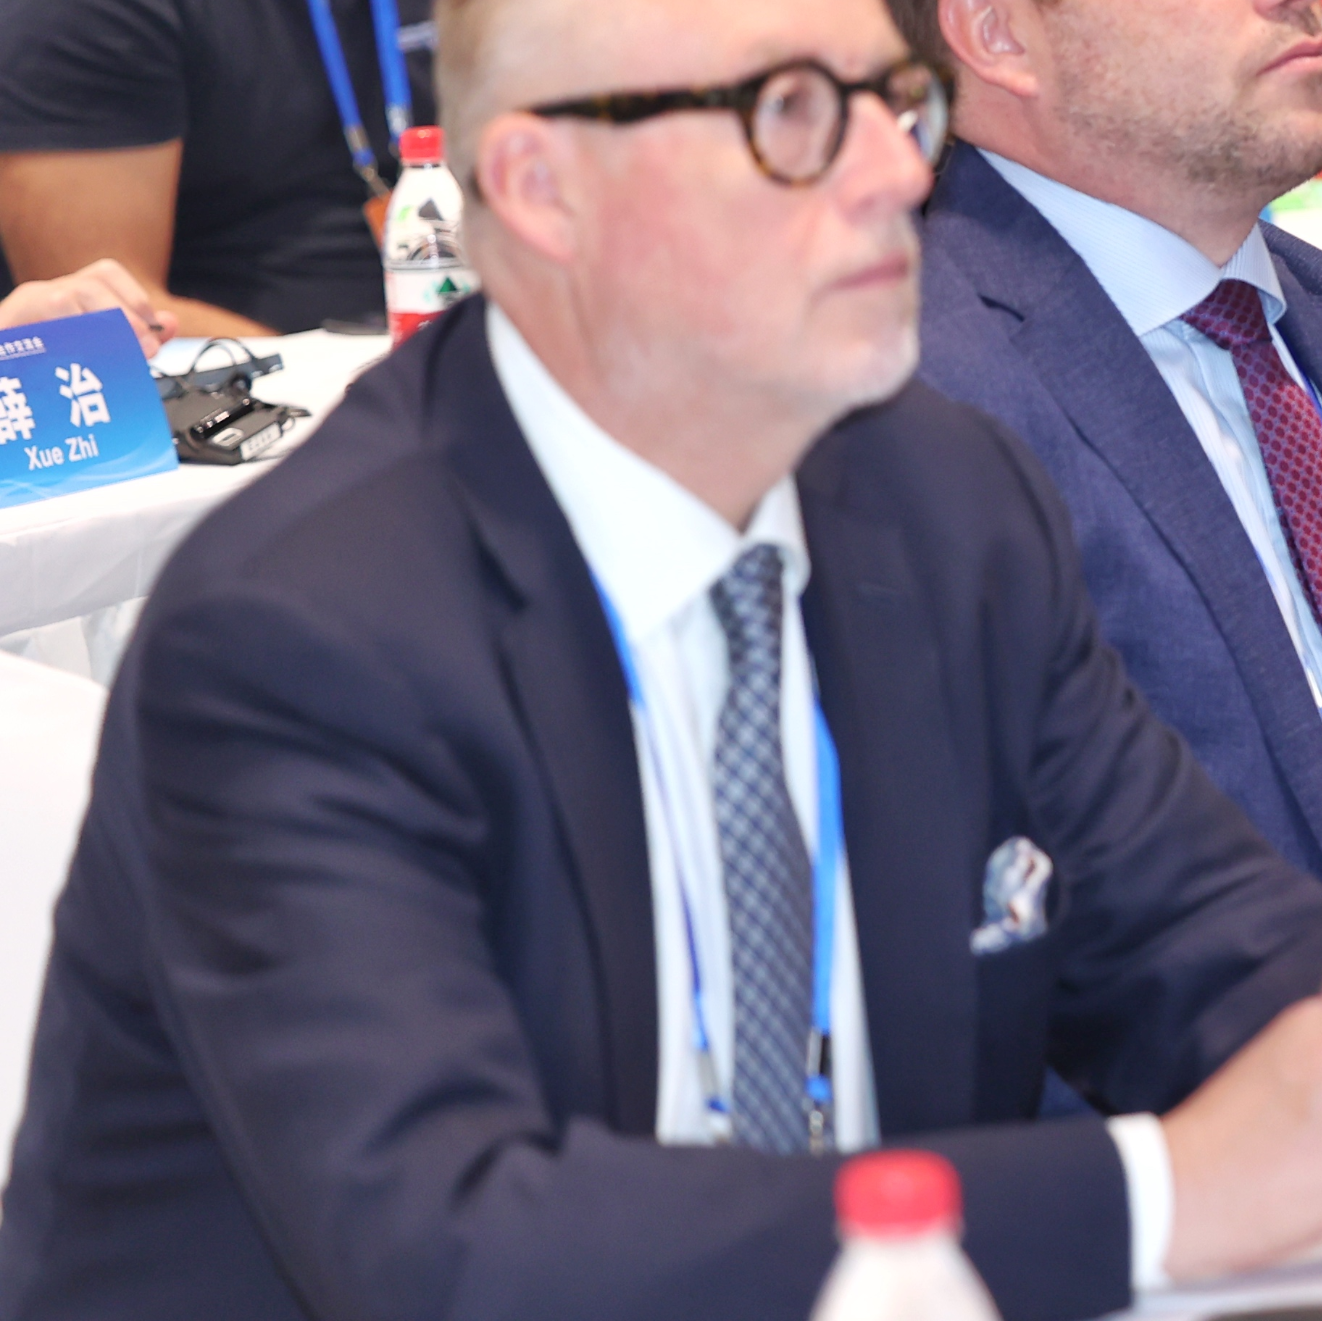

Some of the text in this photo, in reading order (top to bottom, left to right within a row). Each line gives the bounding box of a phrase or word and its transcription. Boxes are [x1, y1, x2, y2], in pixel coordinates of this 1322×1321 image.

[55, 362, 111, 428] 治
[24, 434, 99, 471] Xue Zhi
